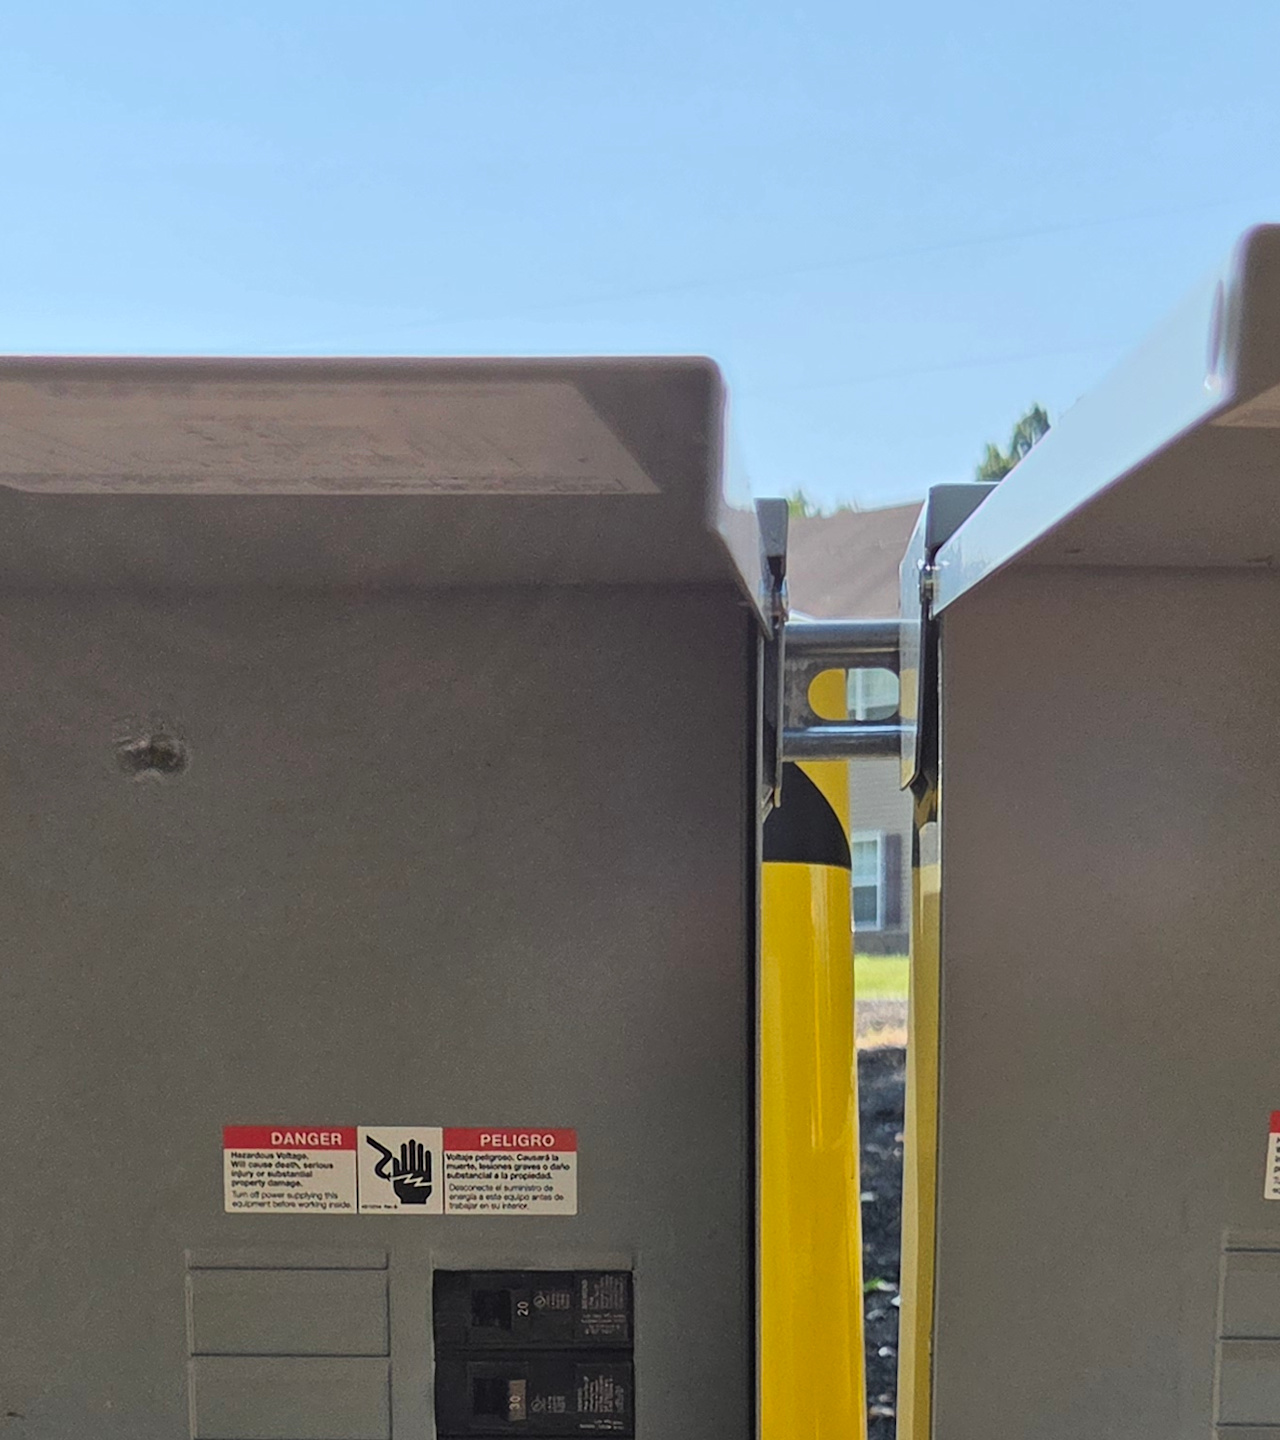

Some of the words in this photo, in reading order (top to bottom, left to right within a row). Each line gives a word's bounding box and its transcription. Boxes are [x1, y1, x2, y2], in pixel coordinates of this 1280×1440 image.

[271, 1131, 342, 1146] DANGER
[480, 1134, 555, 1147] PELIGRO
[276, 1152, 309, 1161] Voltage.
[446, 1154, 473, 1162] Voltaje
[475, 1154, 514, 1162] peligroso.
[514, 1163, 541, 1171] graves
[510, 1172, 552, 1180] propiedad.
[231, 1180, 265, 1188] property
[267, 1180, 303, 1188] damage.
[517, 1300, 530, 1317] 20
[509, 1394, 521, 1411] 30
